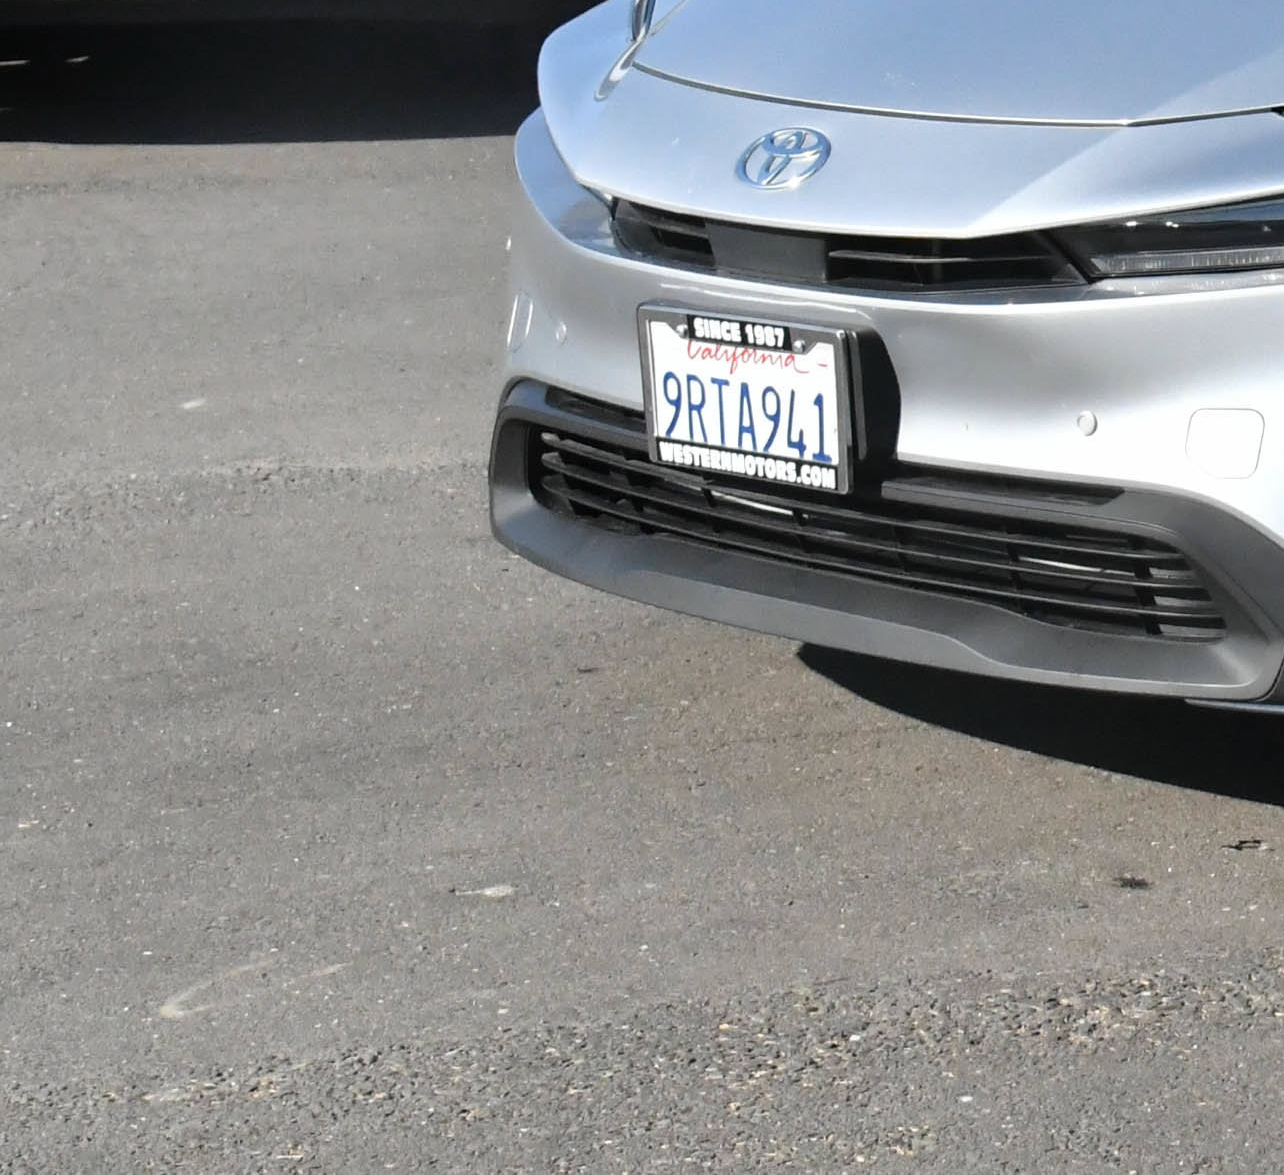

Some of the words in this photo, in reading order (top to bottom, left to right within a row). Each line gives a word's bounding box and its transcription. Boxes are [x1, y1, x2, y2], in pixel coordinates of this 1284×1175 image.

[693, 316, 742, 342] SINCE
[744, 323, 786, 348] 1987
[686, 339, 809, 375] California
[662, 371, 833, 464] 9RTA941
[658, 441, 836, 490] WESTERNMOTORS.COM
